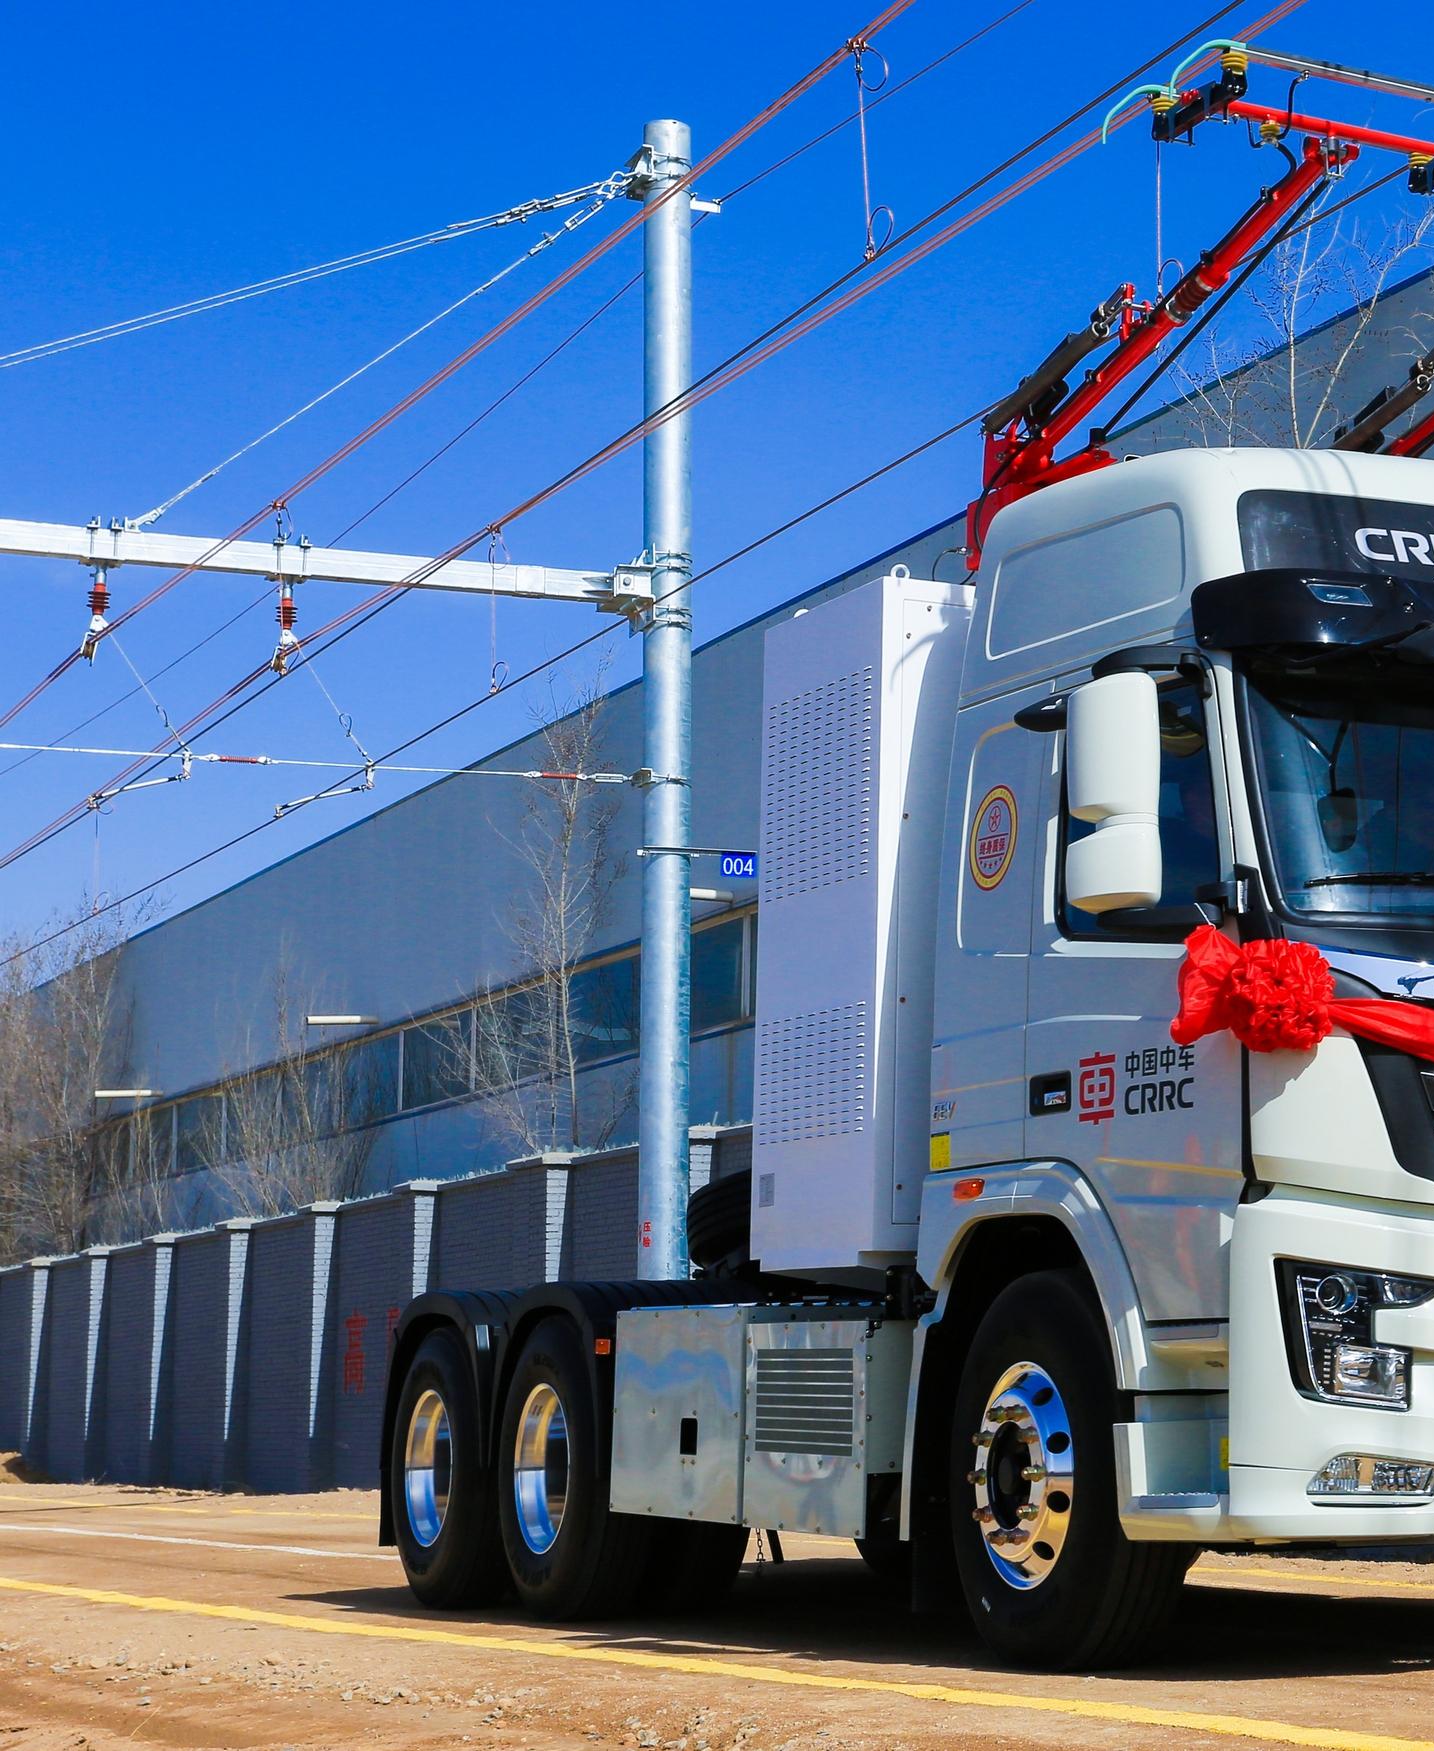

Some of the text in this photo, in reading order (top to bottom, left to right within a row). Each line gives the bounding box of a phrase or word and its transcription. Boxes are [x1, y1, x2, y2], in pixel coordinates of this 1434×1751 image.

[722, 857, 754, 876] 004
[1125, 1045, 1195, 1079] 中国中车
[1124, 1077, 1195, 1115] CRRC
